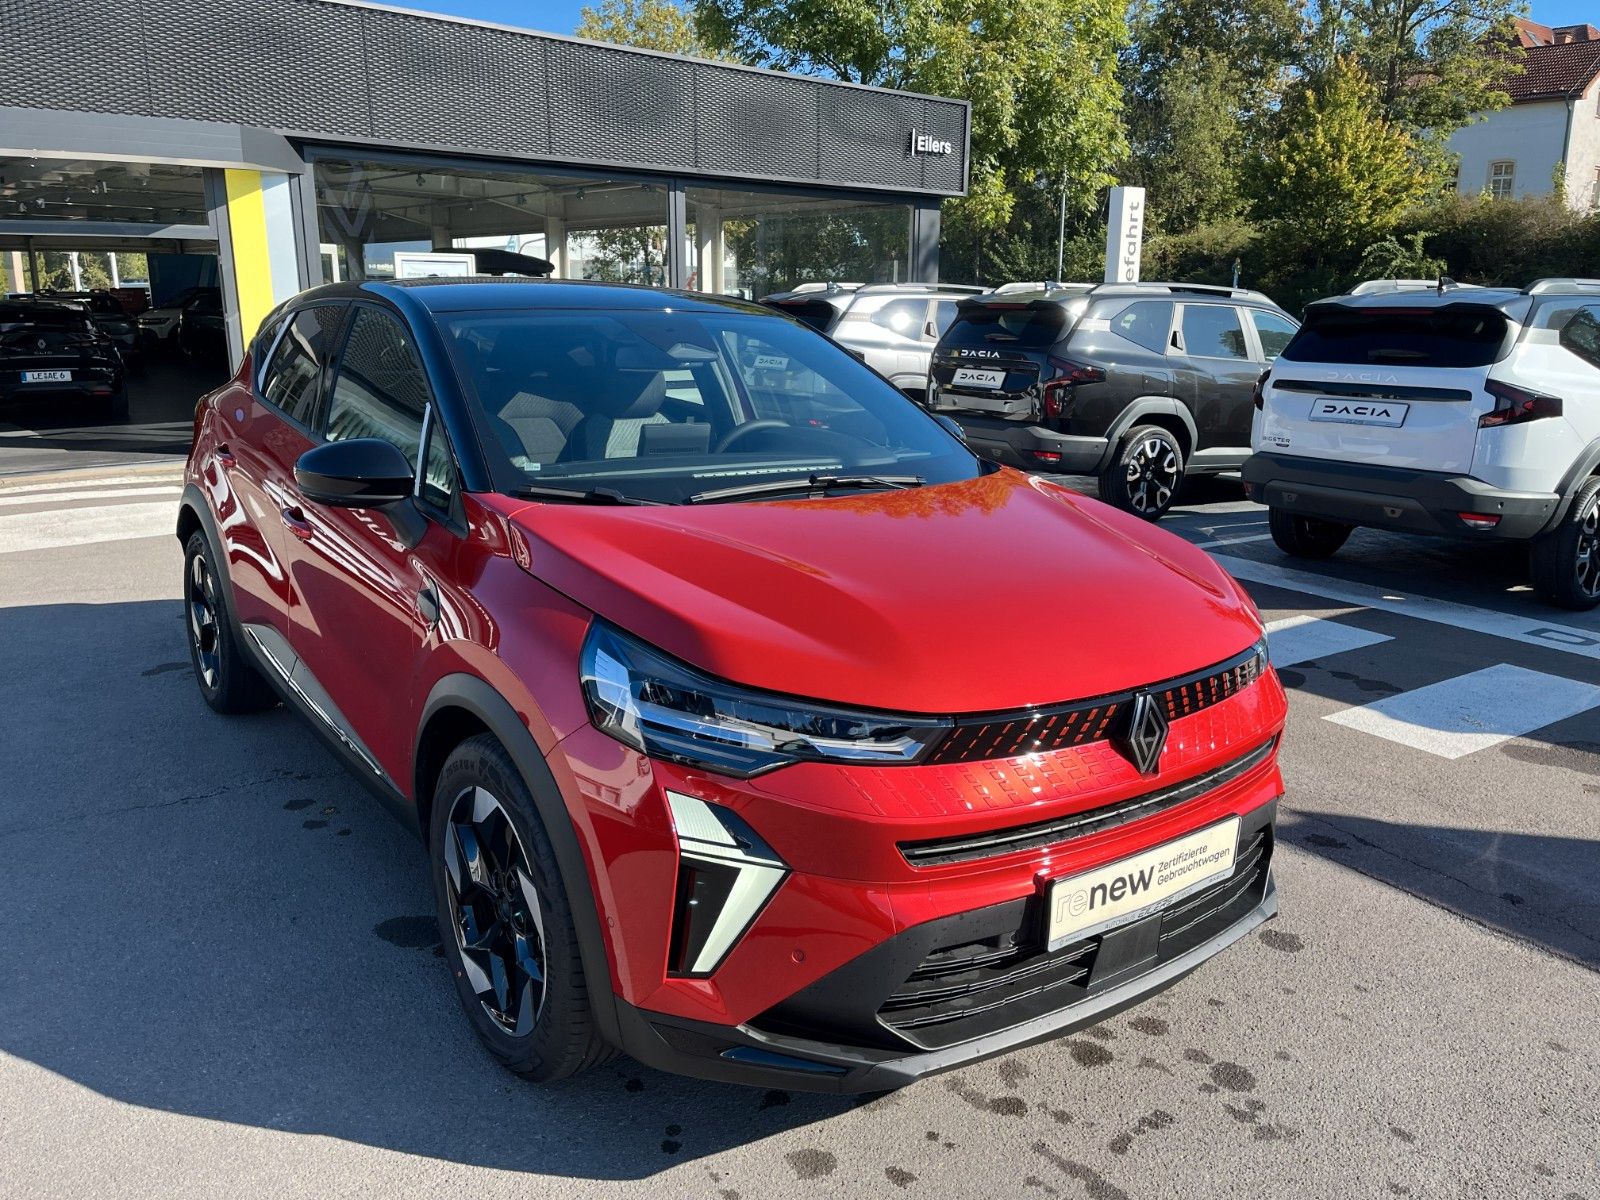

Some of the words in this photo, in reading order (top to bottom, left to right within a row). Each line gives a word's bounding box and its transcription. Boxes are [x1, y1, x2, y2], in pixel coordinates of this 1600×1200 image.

[917, 135, 951, 154] Eilers
[961, 349, 1000, 358] DACIA
[60, 372, 66, 380] 6
[960, 372, 996, 382] DACIA
[1326, 371, 1399, 383] DACIA
[1322, 404, 1391, 418] DACIA
[1262, 435, 1291, 443] BIGSTER
[1158, 844, 1208, 873] Zertifizierte
[1157, 847, 1231, 886] Gebrauchtwagen
